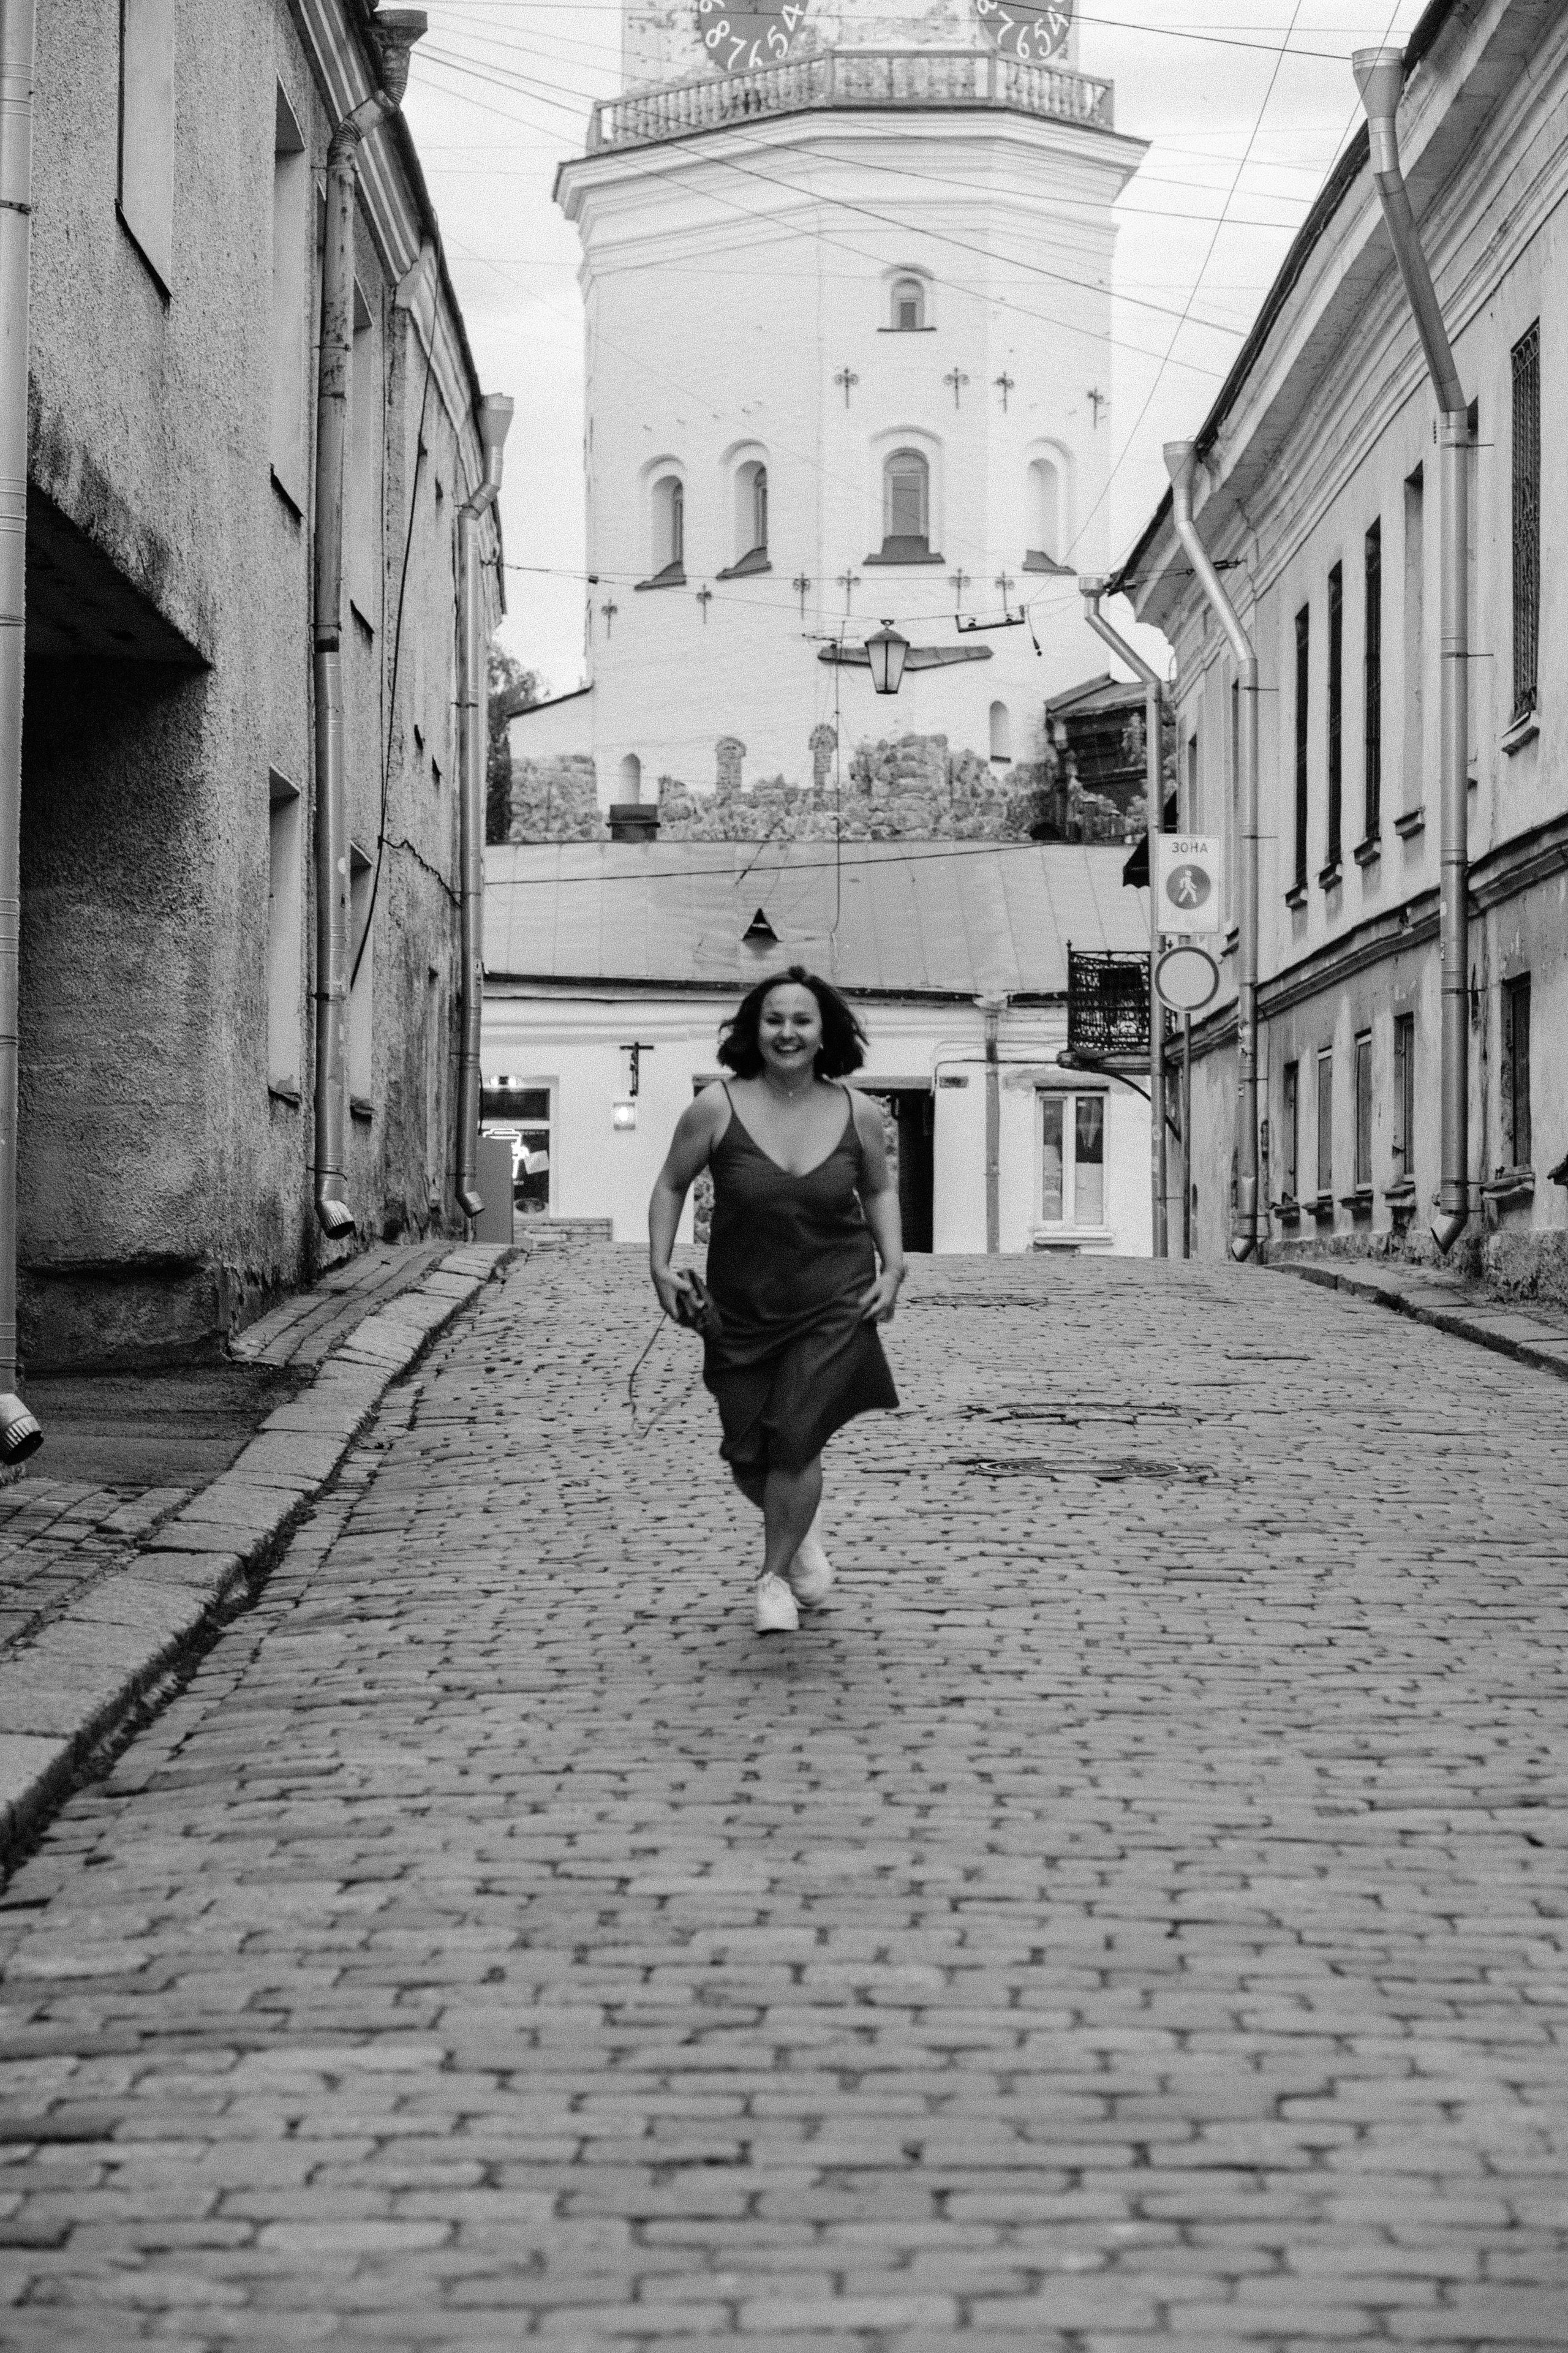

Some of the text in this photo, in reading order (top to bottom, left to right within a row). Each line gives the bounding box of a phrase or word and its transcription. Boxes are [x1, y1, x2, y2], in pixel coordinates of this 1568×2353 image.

[706, 20, 730, 47] 8
[782, 4, 805, 31] 4
[997, 10, 1014, 44] 7
[1047, 6, 1069, 36] 4
[728, 36, 747, 70] 7
[767, 25, 788, 59] 5
[1017, 26, 1030, 59] 6
[1032, 18, 1051, 56] 5
[1172, 841, 1208, 853] ЗОНА
